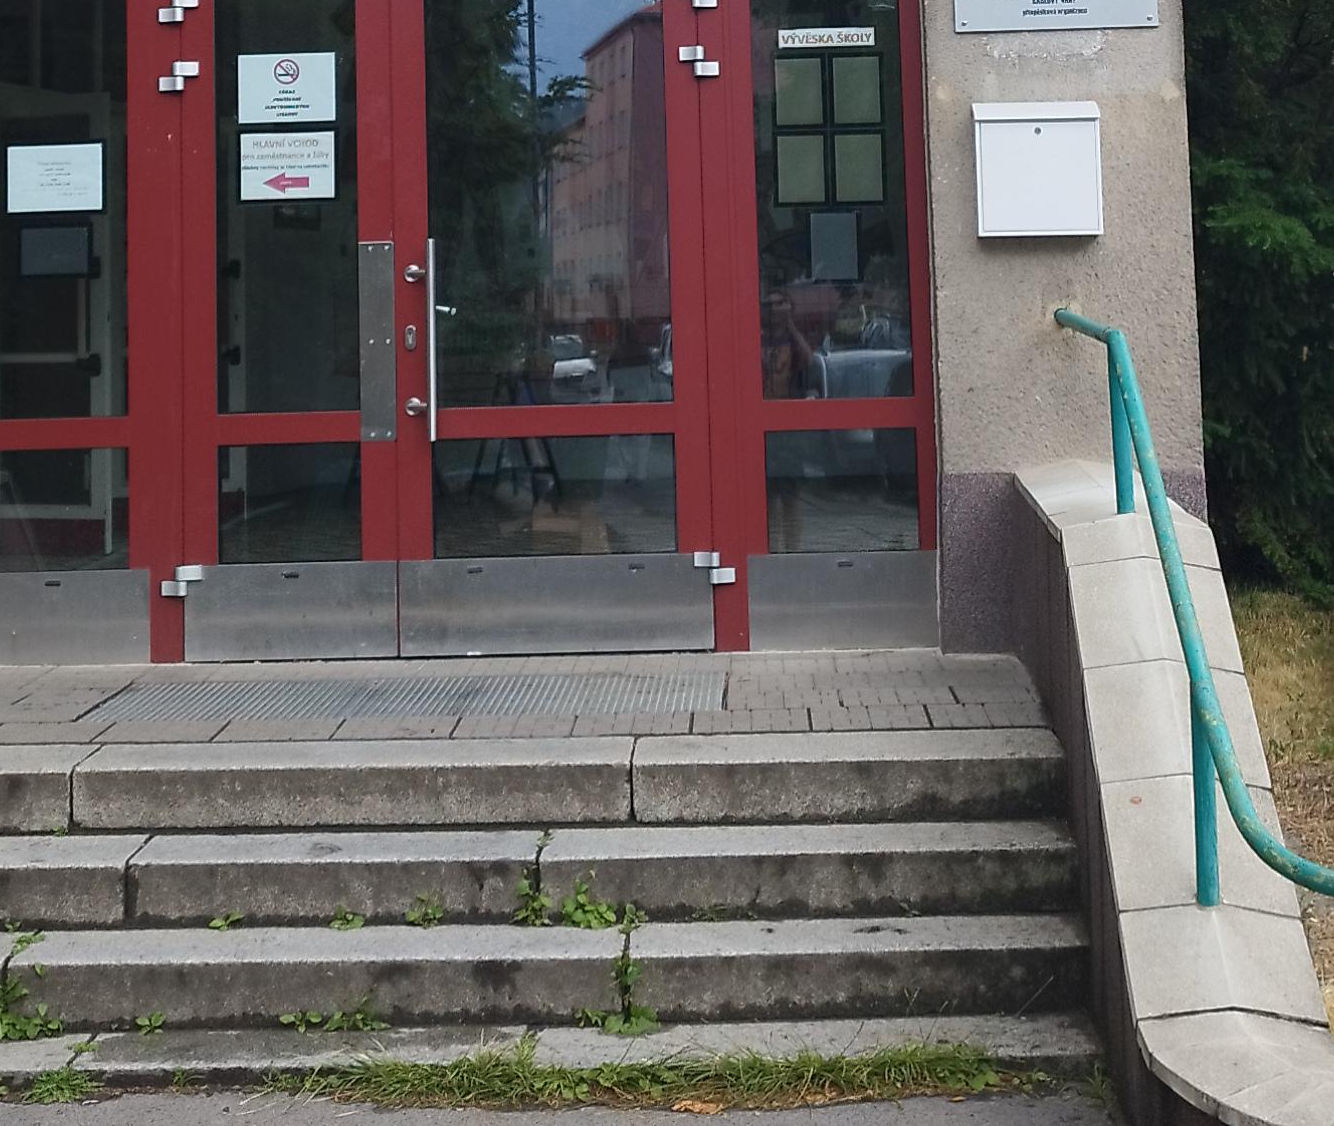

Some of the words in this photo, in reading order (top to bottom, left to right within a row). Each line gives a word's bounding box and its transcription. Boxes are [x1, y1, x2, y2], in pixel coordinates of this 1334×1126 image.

[781, 31, 834, 45] VÝVĚSKA
[836, 30, 872, 44] ŠKOLY
[252, 138, 285, 149] HLAVNÍ
